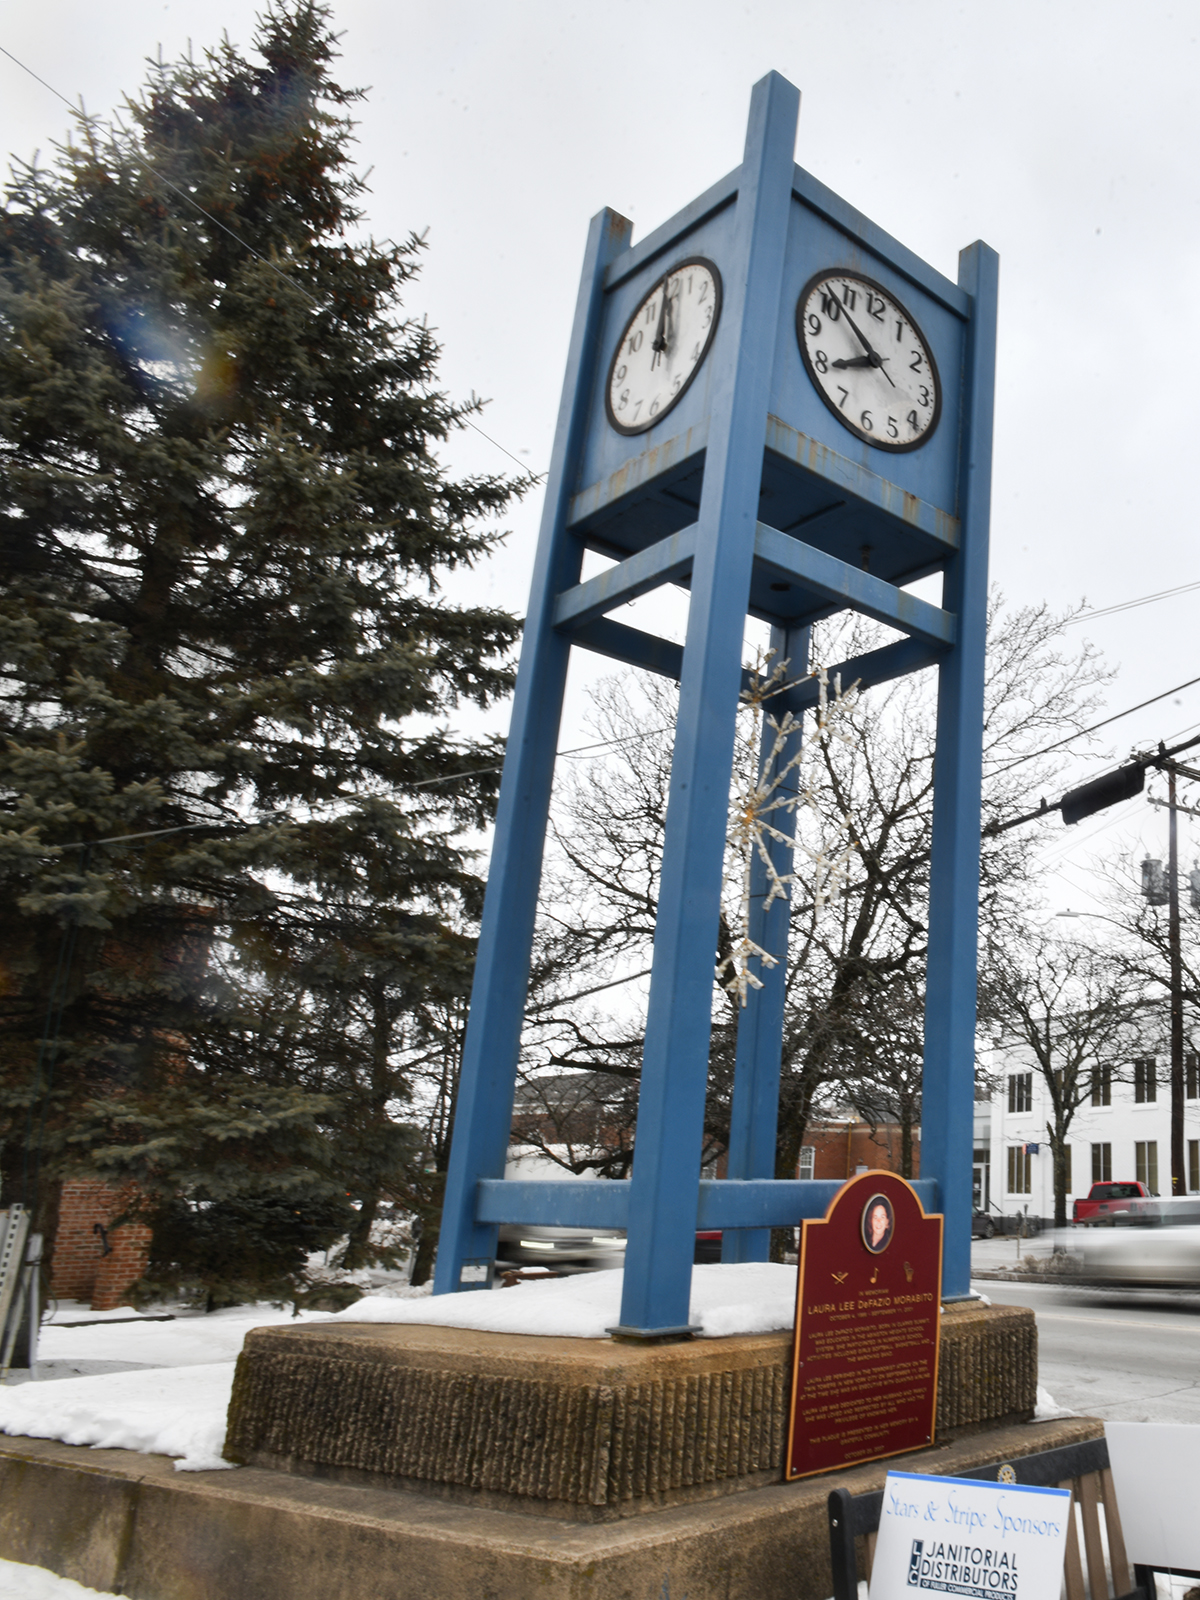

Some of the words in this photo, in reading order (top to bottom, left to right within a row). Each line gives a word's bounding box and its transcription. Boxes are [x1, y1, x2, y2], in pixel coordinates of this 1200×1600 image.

[688, 274, 693, 295] 1
[698, 281, 708, 305] 2
[819, 291, 840, 322] 10
[842, 283, 856, 311] 11
[866, 292, 885, 322] 12
[645, 302, 656, 325] 11
[702, 305, 712, 329] 3
[808, 314, 821, 336] 9
[628, 330, 643, 355] 10
[896, 320, 904, 342] 1
[691, 341, 700, 362] 4
[815, 350, 828, 374] 8
[910, 351, 922, 374] 2
[616, 365, 627, 388] 9
[670, 374, 681, 396] 5
[618, 389, 630, 411] 8
[650, 393, 661, 417] 6
[837, 385, 849, 408] 7
[917, 385, 929, 407] 3
[633, 399, 643, 421] 7
[860, 410, 873, 431] 6
[907, 410, 919, 431] 4
[887, 416, 898, 438] 5
[808, 1304, 836, 1314] LAURA
[839, 1302, 854, 1311] LEE
[858, 1298, 891, 1309] DeFAZIO
[894, 1293, 933, 1304] MORABITO
[886, 1482, 920, 1518] Stars
[924, 1501, 940, 1522] &
[944, 1489, 987, 1534] Stripe
[993, 1495, 1061, 1538] Sponsors
[926, 1541, 1017, 1570] JANITORIAL
[921, 1559, 1018, 1591] DISTRIBUTORS
[930, 1580, 947, 1591] FULLER
[947, 1583, 984, 1597] COMMERCIAL
[984, 1590, 1014, 1600] PRODUCTS
